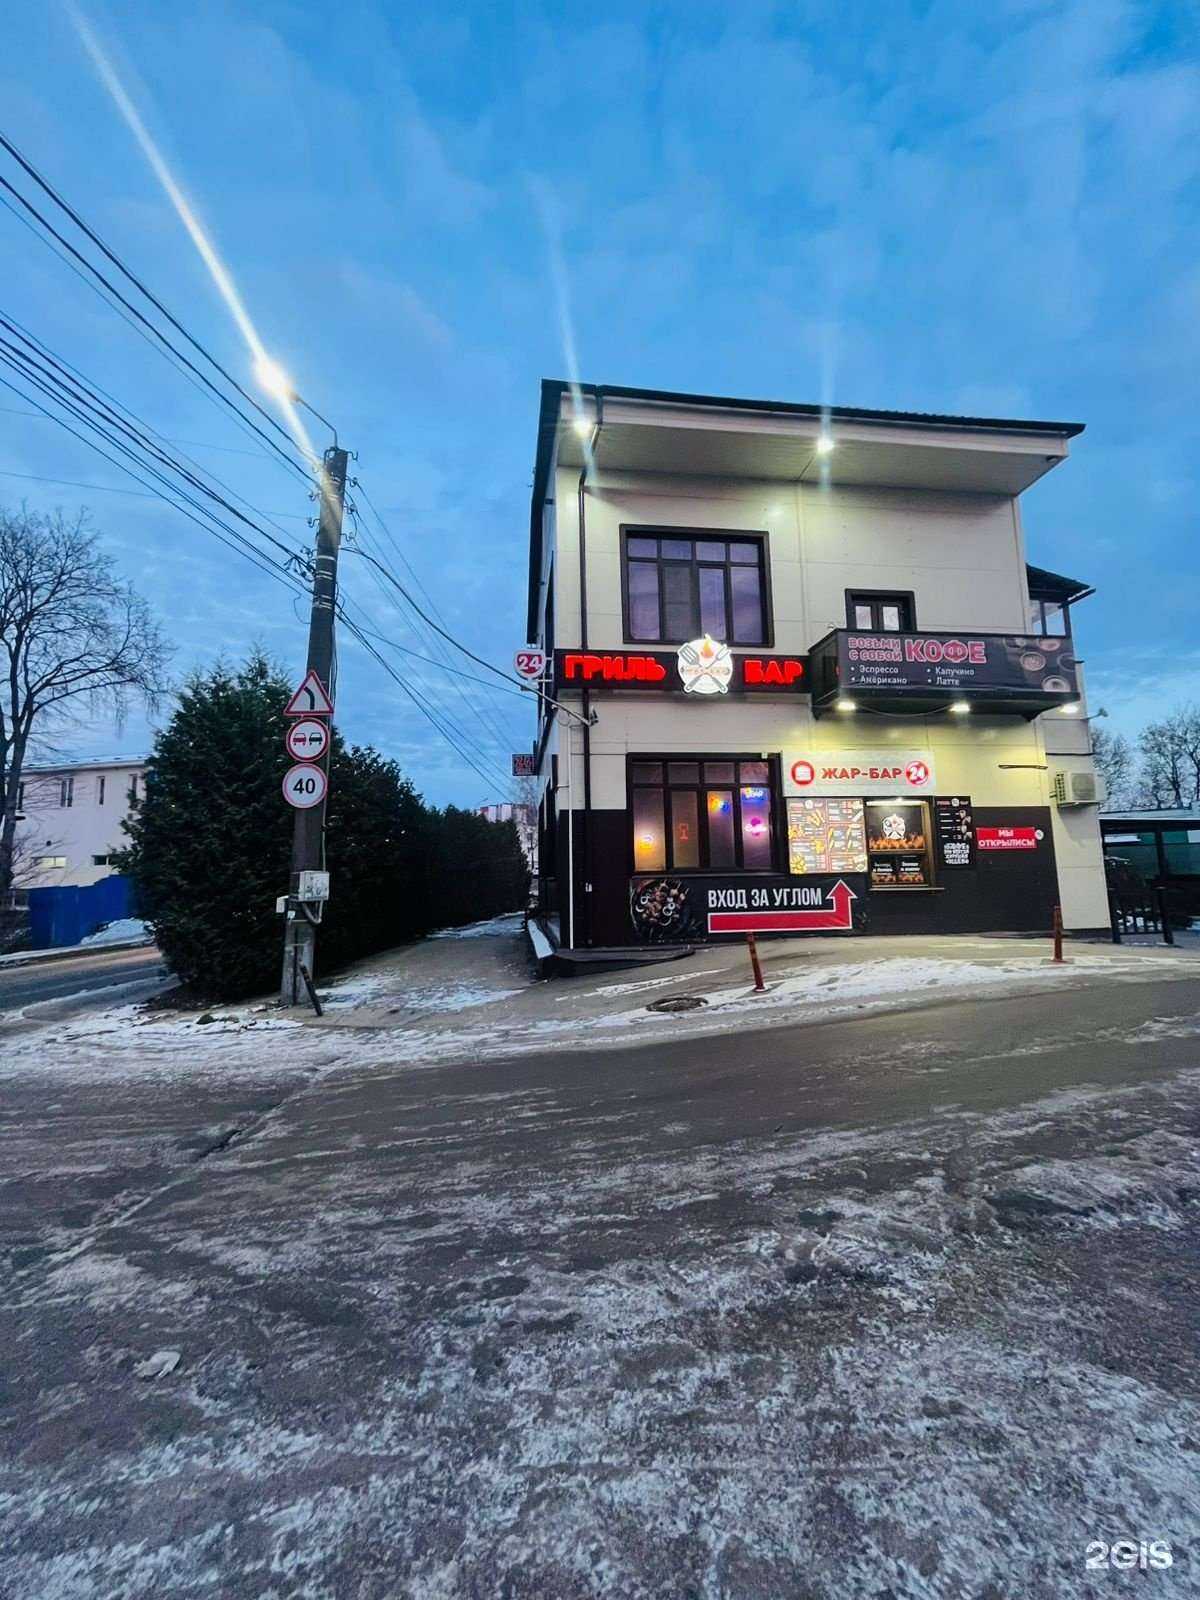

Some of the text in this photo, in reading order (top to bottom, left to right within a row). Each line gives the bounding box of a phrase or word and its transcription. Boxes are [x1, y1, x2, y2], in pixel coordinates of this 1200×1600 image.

[848, 638, 901, 650] ВОЗЬМИ
[849, 650, 903, 662] С СОБОЙ
[904, 639, 987, 663] КОФЕ
[518, 656, 541, 670] 24
[565, 655, 803, 684] ГРИЛЬ БАР
[859, 665, 899, 675] Эспрессо
[935, 666, 975, 676] Капучино
[860, 675, 908, 685] Американо
[936, 677, 960, 686] Латте
[821, 767, 902, 779] ЖАР-БАР
[293, 778, 316, 794] 40
[998, 829, 1014, 837] МЫ
[708, 887, 823, 908] ВХОД ЗА УГЛОМ
